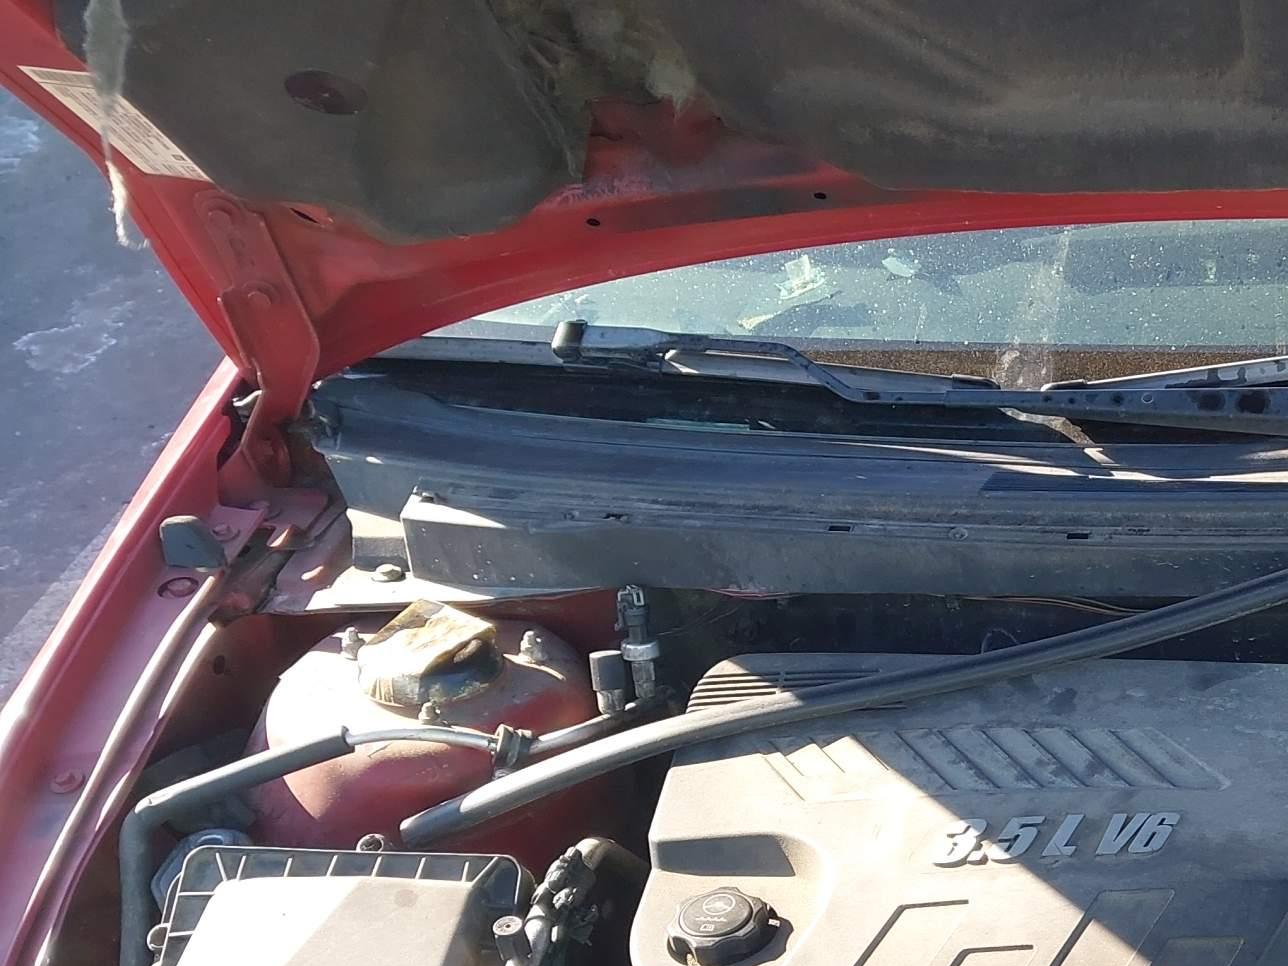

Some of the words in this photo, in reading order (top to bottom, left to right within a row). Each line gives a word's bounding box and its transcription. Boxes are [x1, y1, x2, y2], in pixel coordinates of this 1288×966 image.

[933, 816, 1046, 867] 3.5
[1041, 814, 1085, 857] L
[1096, 812, 1181, 855] V6
